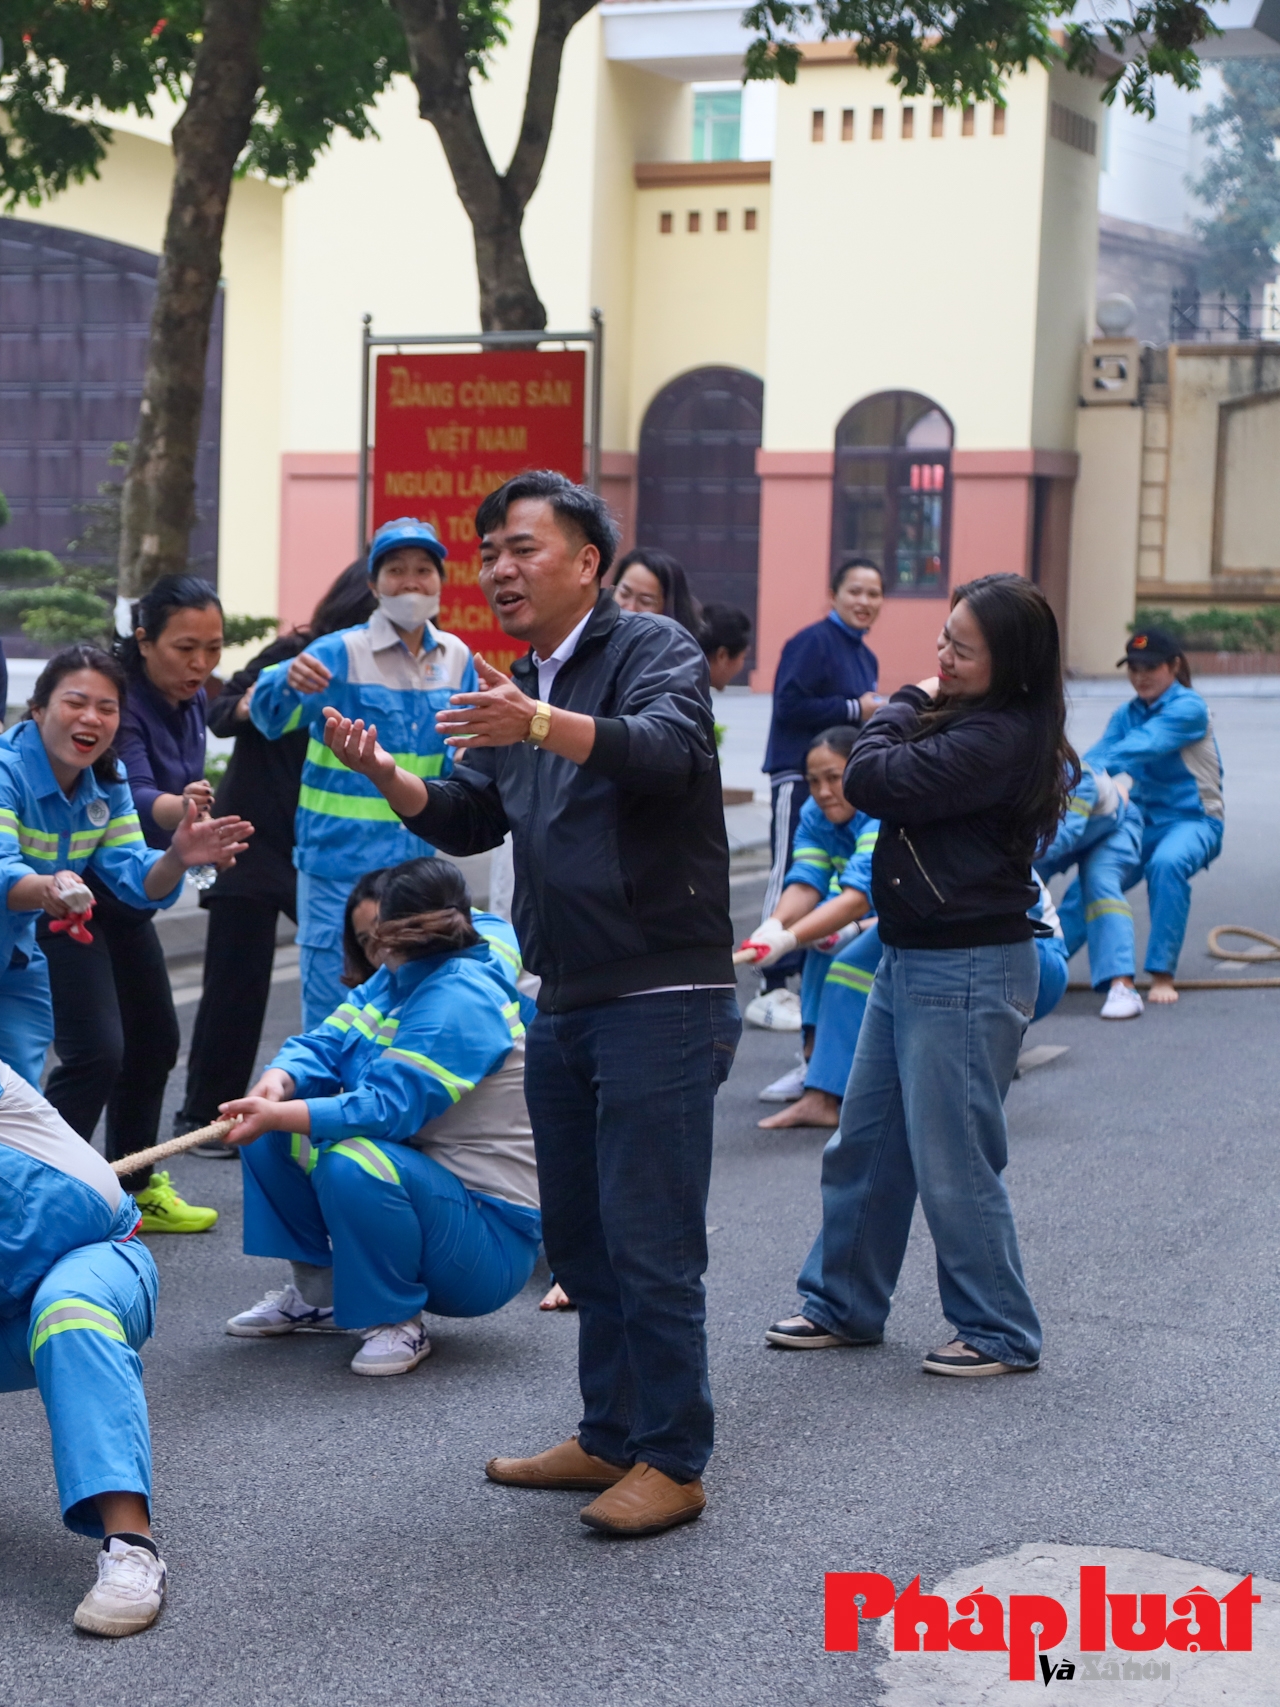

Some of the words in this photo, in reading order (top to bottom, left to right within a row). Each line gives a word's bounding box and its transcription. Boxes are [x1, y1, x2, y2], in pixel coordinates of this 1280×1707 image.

[459, 374, 521, 416] CỘNG
[525, 370, 572, 408] SẢN
[426, 420, 473, 458] VIỆT
[475, 425, 528, 452] NAM
[385, 466, 453, 497] NGƯỜI
